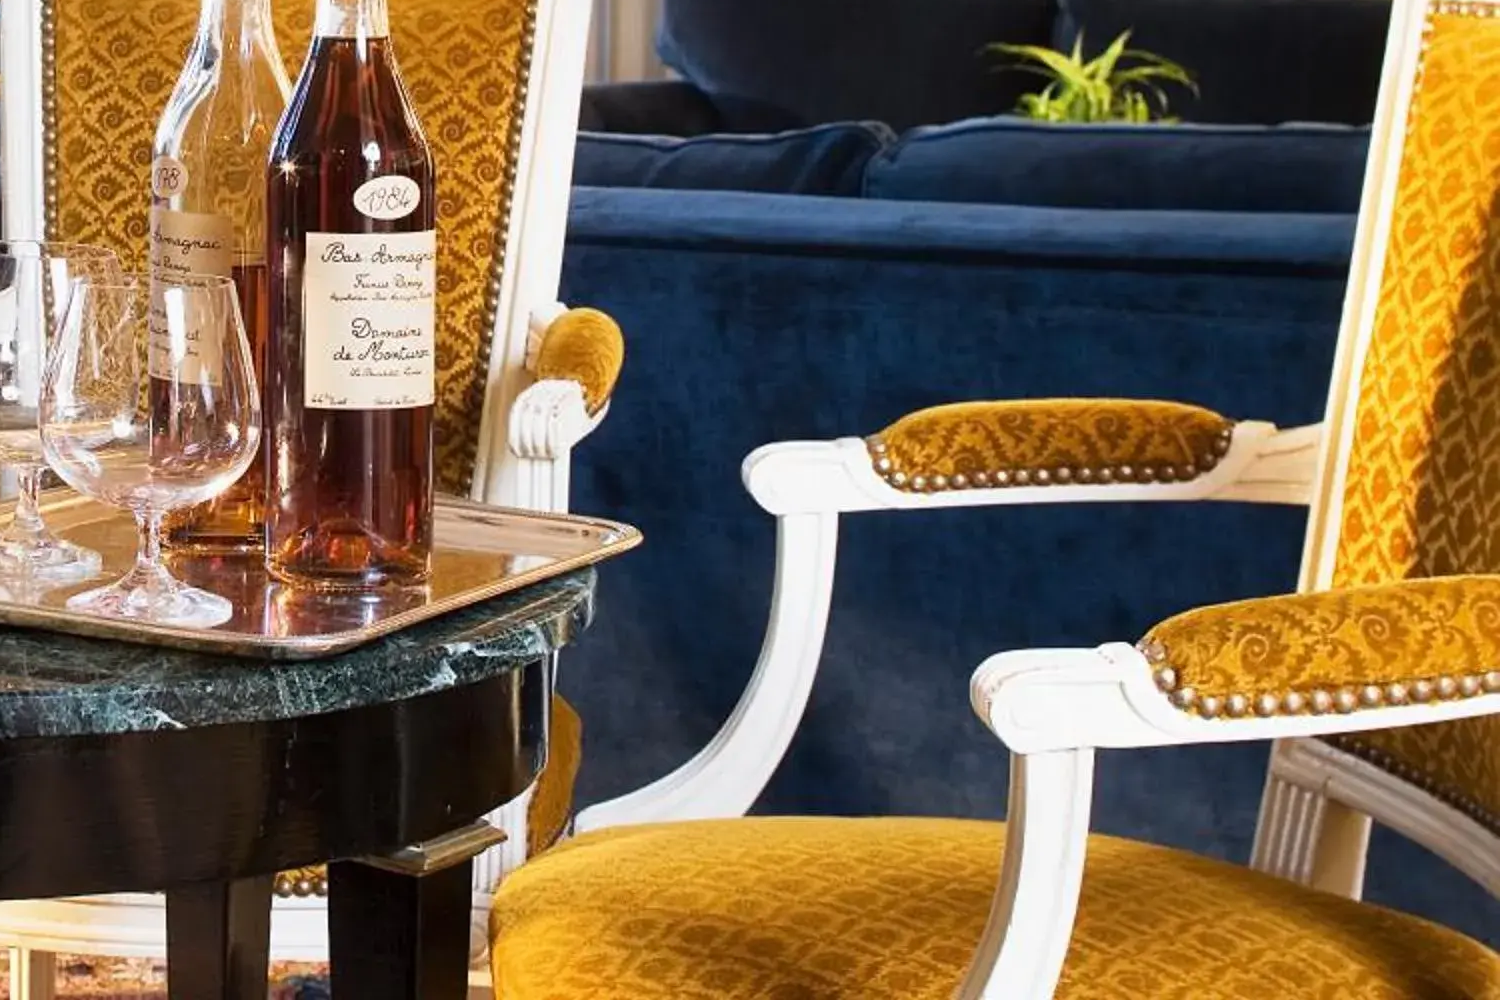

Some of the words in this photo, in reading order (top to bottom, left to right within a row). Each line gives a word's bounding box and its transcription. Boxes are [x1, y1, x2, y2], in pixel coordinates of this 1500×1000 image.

[362, 187, 411, 212] 1984
[321, 241, 362, 263] Bas
[351, 317, 421, 339] Domaine
[333, 345, 354, 361] de
